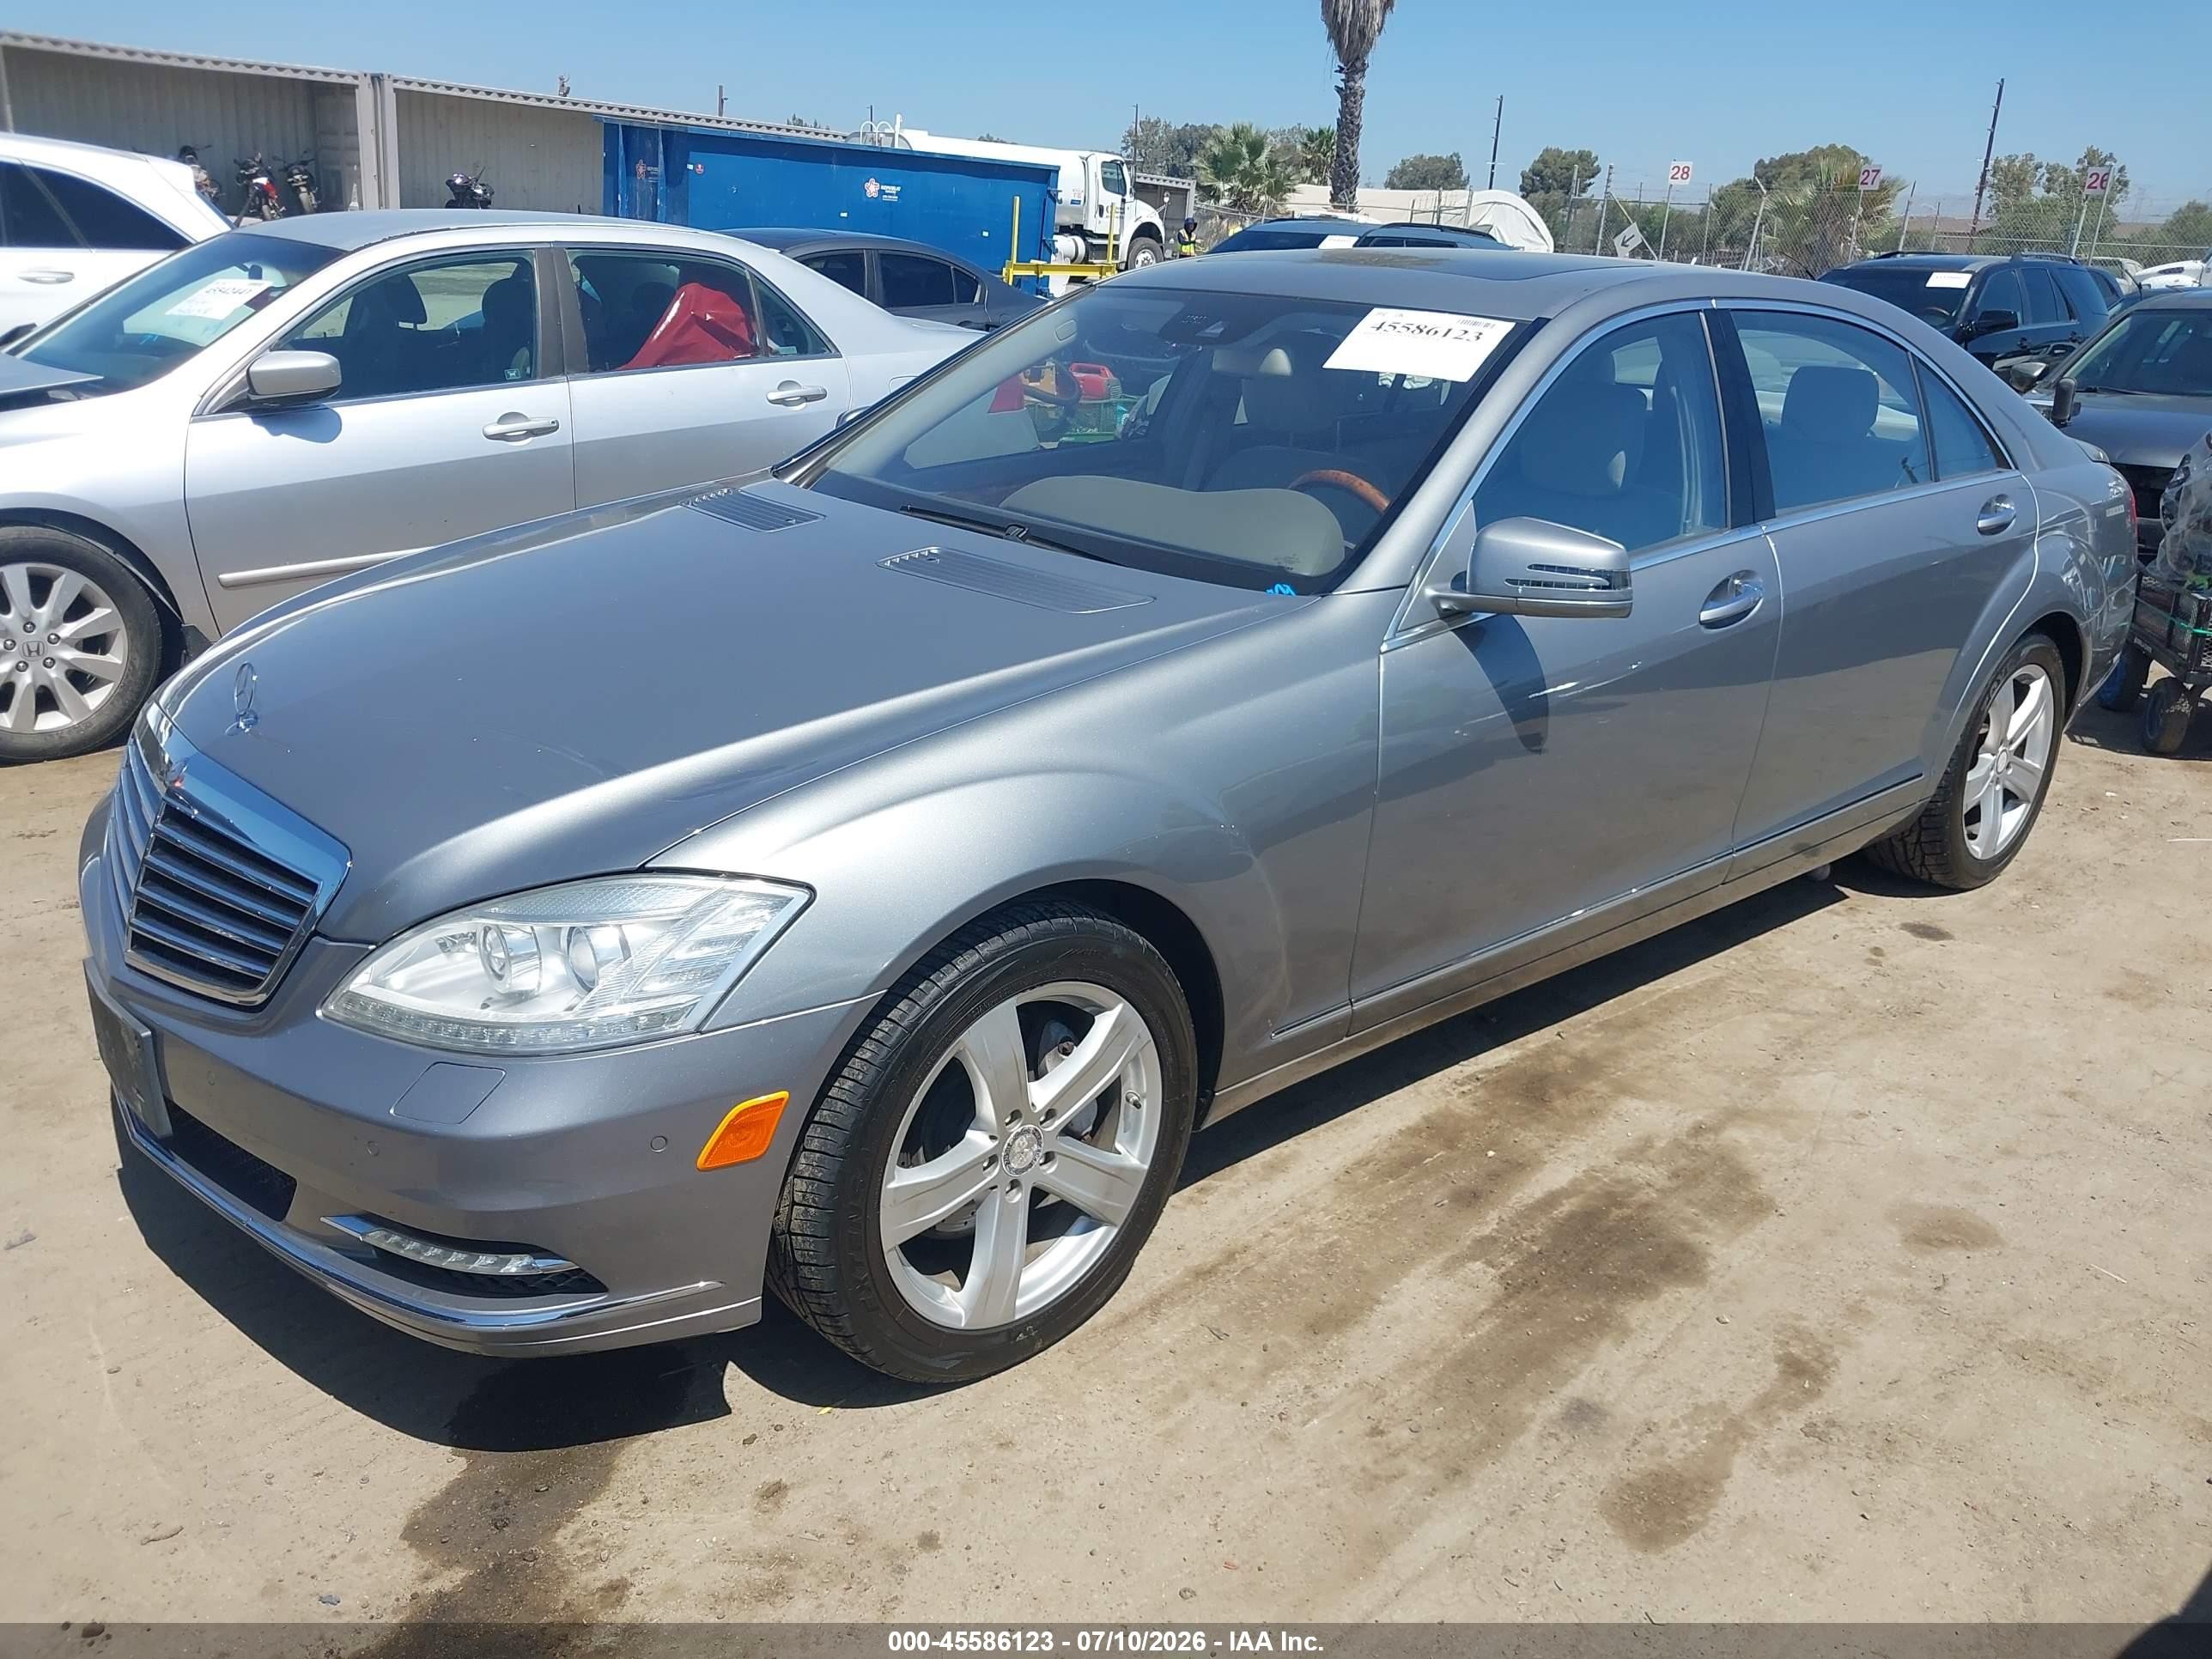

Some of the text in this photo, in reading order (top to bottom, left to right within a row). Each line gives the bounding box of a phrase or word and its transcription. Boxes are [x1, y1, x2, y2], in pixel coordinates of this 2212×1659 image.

[1670, 166, 1690, 180] 28
[1860, 168, 1881, 185] 27
[1371, 320, 1484, 343] 45586123
